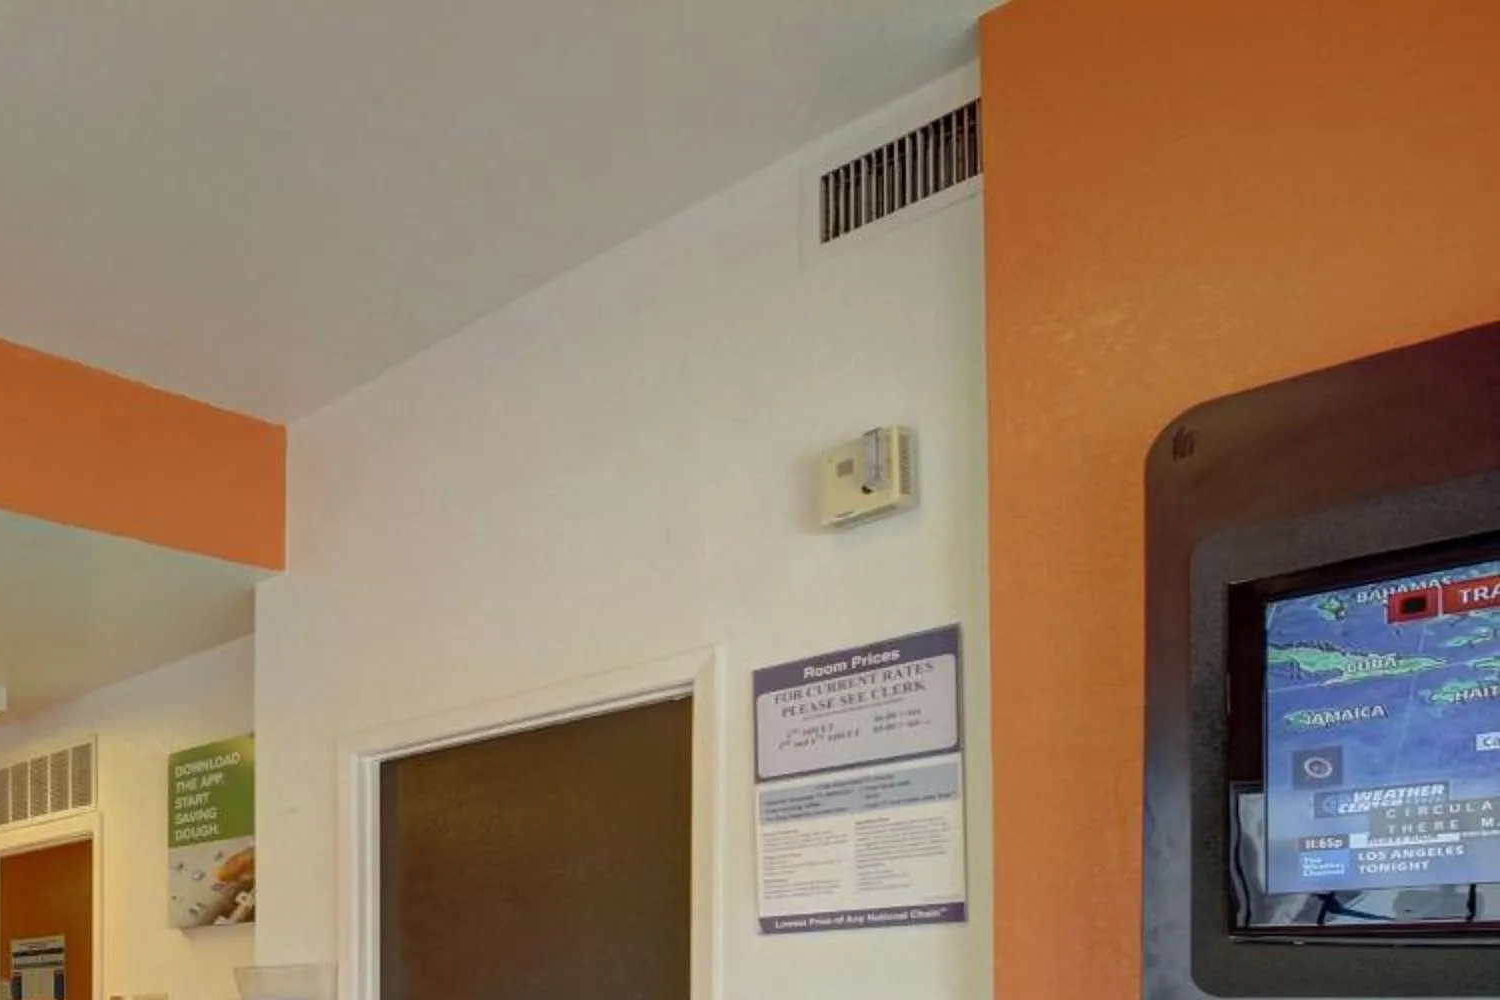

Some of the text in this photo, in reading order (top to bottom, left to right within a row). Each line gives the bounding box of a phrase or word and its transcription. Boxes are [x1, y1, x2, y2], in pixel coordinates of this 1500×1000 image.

[803, 650, 901, 679] Room Prices
[1348, 657, 1396, 673] CUBA
[775, 661, 934, 705] FOR CURRENT RATES
[781, 680, 926, 718] PLEASE SEE CLERK
[1304, 705, 1386, 727] JAMAICA
[175, 752, 240, 779] DOWNLOAD
[176, 778, 198, 793] THE
[1352, 783, 1445, 802] WEATHER
[174, 792, 211, 809] START
[174, 807, 218, 825] SAVING
[1387, 819, 1460, 834] THERE
[1357, 845, 1466, 861] LOS ANGELES
[1358, 860, 1430, 874] TONIGHT
